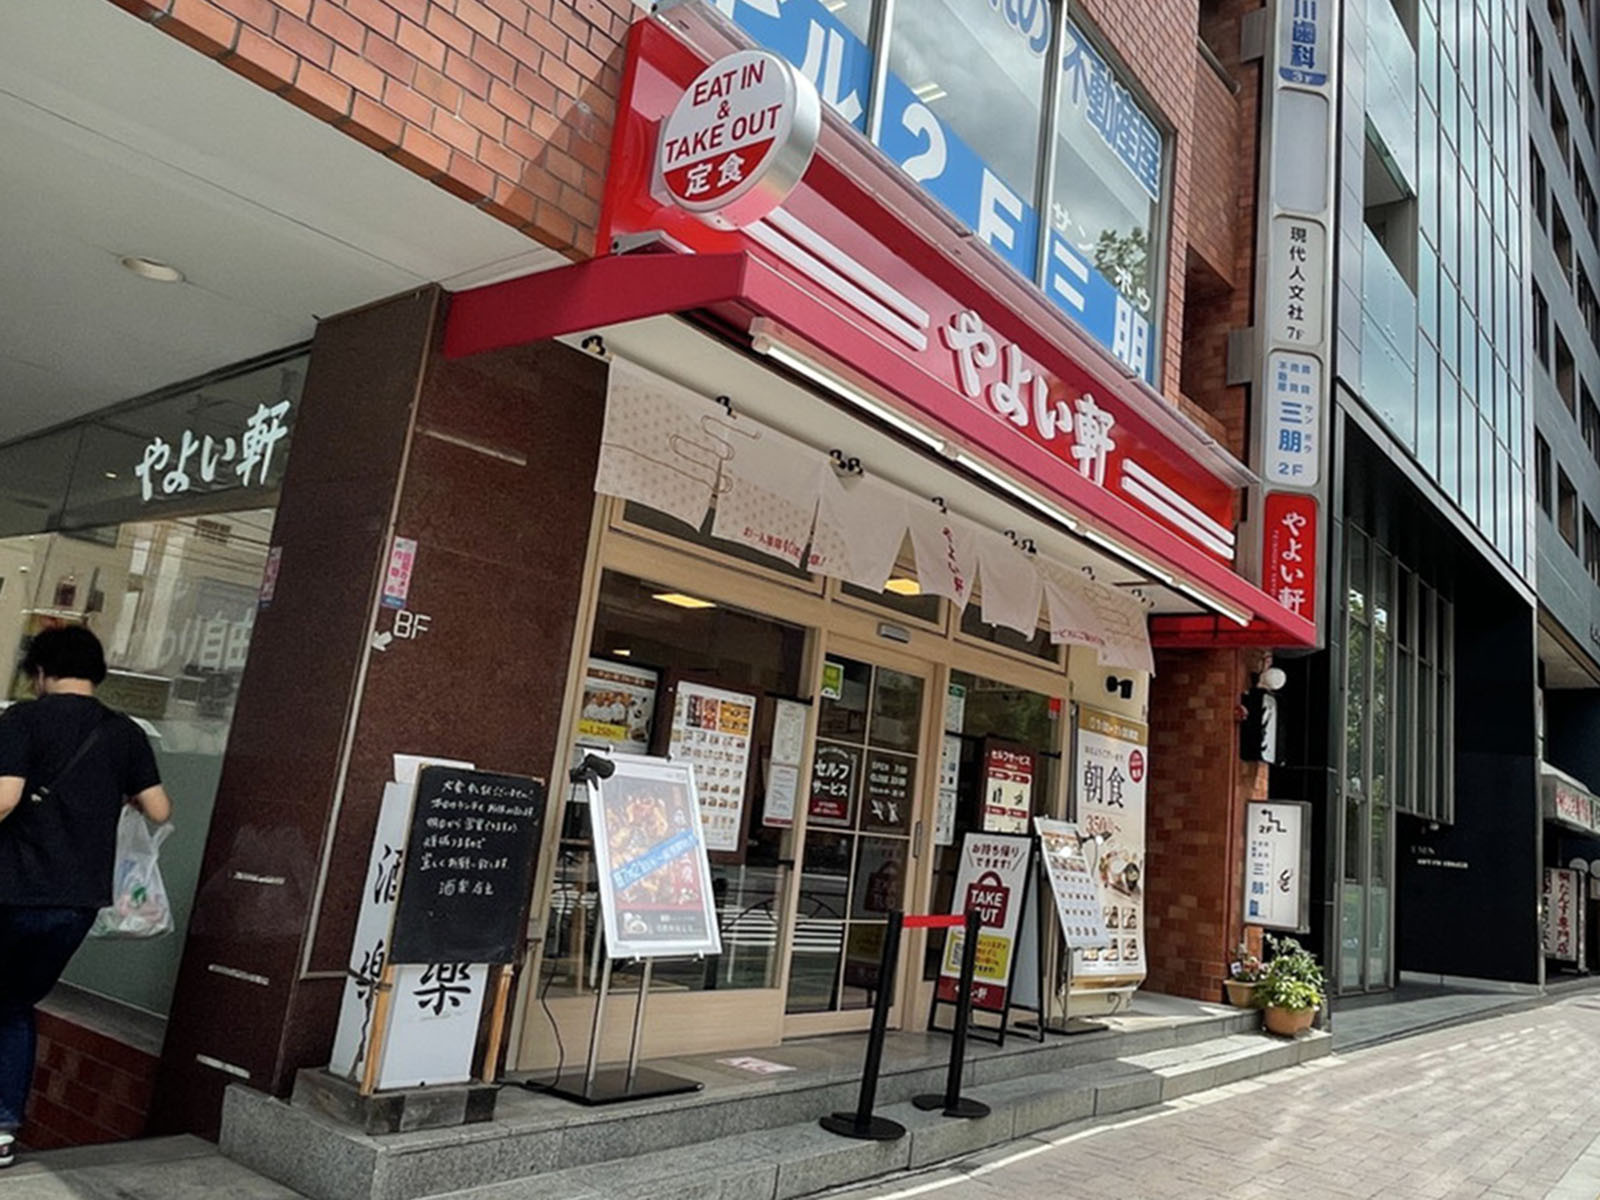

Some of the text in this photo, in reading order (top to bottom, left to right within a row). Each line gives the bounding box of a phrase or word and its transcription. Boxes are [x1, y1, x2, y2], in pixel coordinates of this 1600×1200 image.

[693, 60, 765, 107] EAT IN
[988, 0, 1161, 202] の不動産屋
[717, 100, 731, 119] &
[665, 104, 783, 164] TAKE OUT
[685, 152, 745, 198] 定食
[1288, 226, 1307, 321] 現代人文社
[1287, 326, 1305, 341] 7F
[944, 309, 1116, 487] やよい軒
[135, 400, 291, 502] やよい軒
[1279, 401, 1303, 454] 三朋
[1278, 462, 1304, 476] 2F
[1278, 512, 1307, 615] やよい軒
[813, 781, 847, 797] サービス
[815, 760, 849, 779] セルフ
[1083, 760, 1125, 808] 朝食
[972, 843, 1019, 859] お持ち帰り
[970, 889, 1003, 908] TAKE
[974, 907, 999, 924] UT
[413, 963, 472, 1016] 楽
